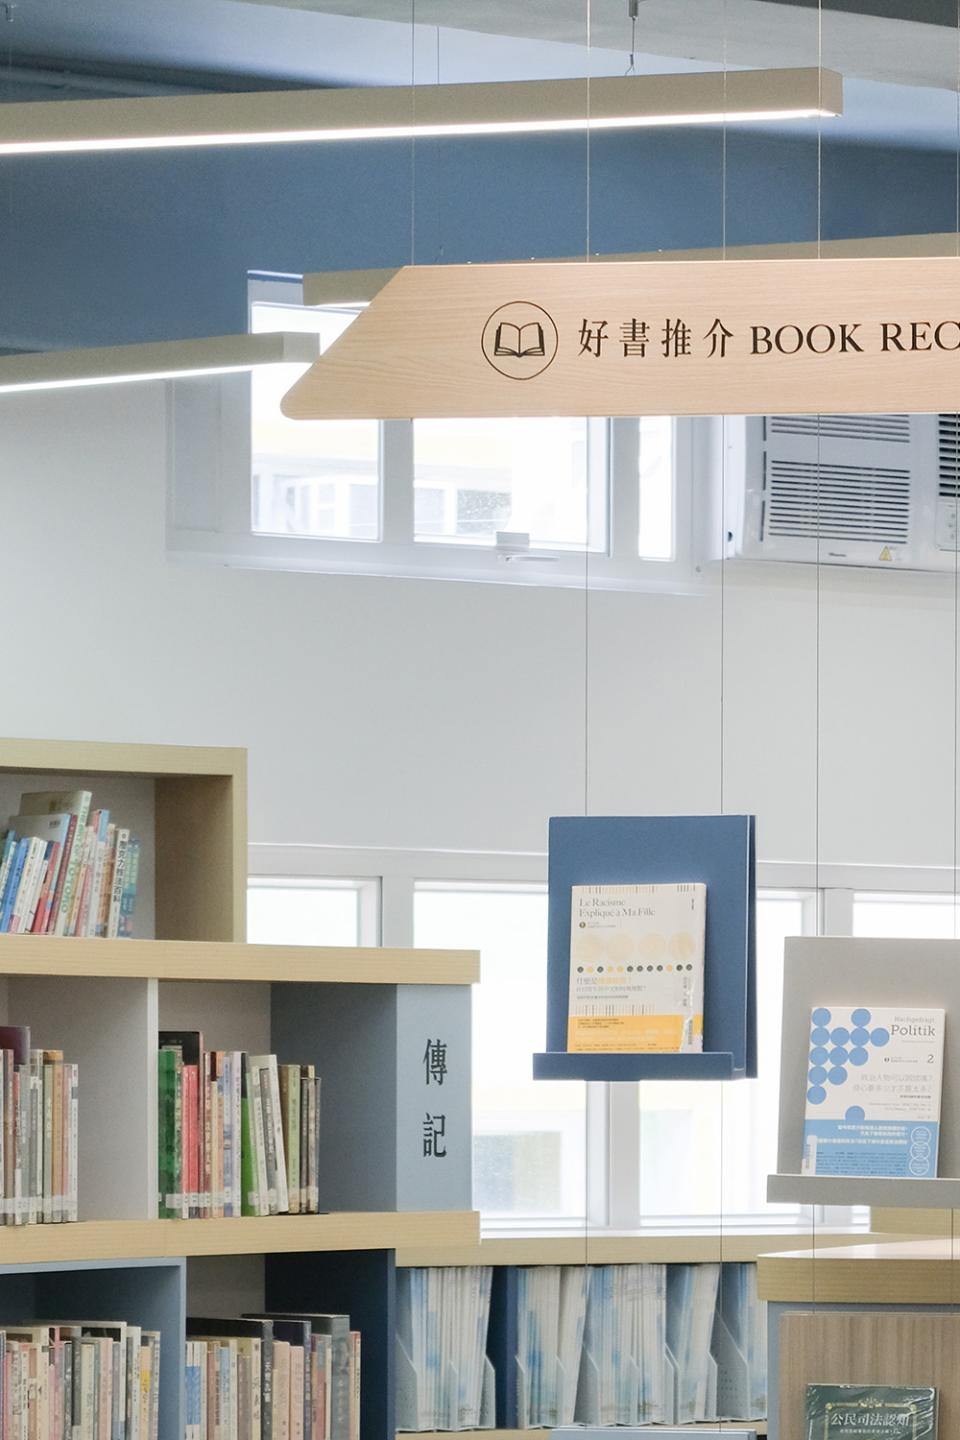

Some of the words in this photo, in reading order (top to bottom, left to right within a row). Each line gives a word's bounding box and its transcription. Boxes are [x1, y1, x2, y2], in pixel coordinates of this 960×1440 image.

[578, 317, 735, 359] 好書推介
[750, 322, 863, 356] BOOK
[890, 1024, 936, 1038] Politik
[926, 1054, 935, 1064] 2
[422, 1038, 448, 1158] 傳記
[830, 1412, 911, 1427] 公民司法認知
